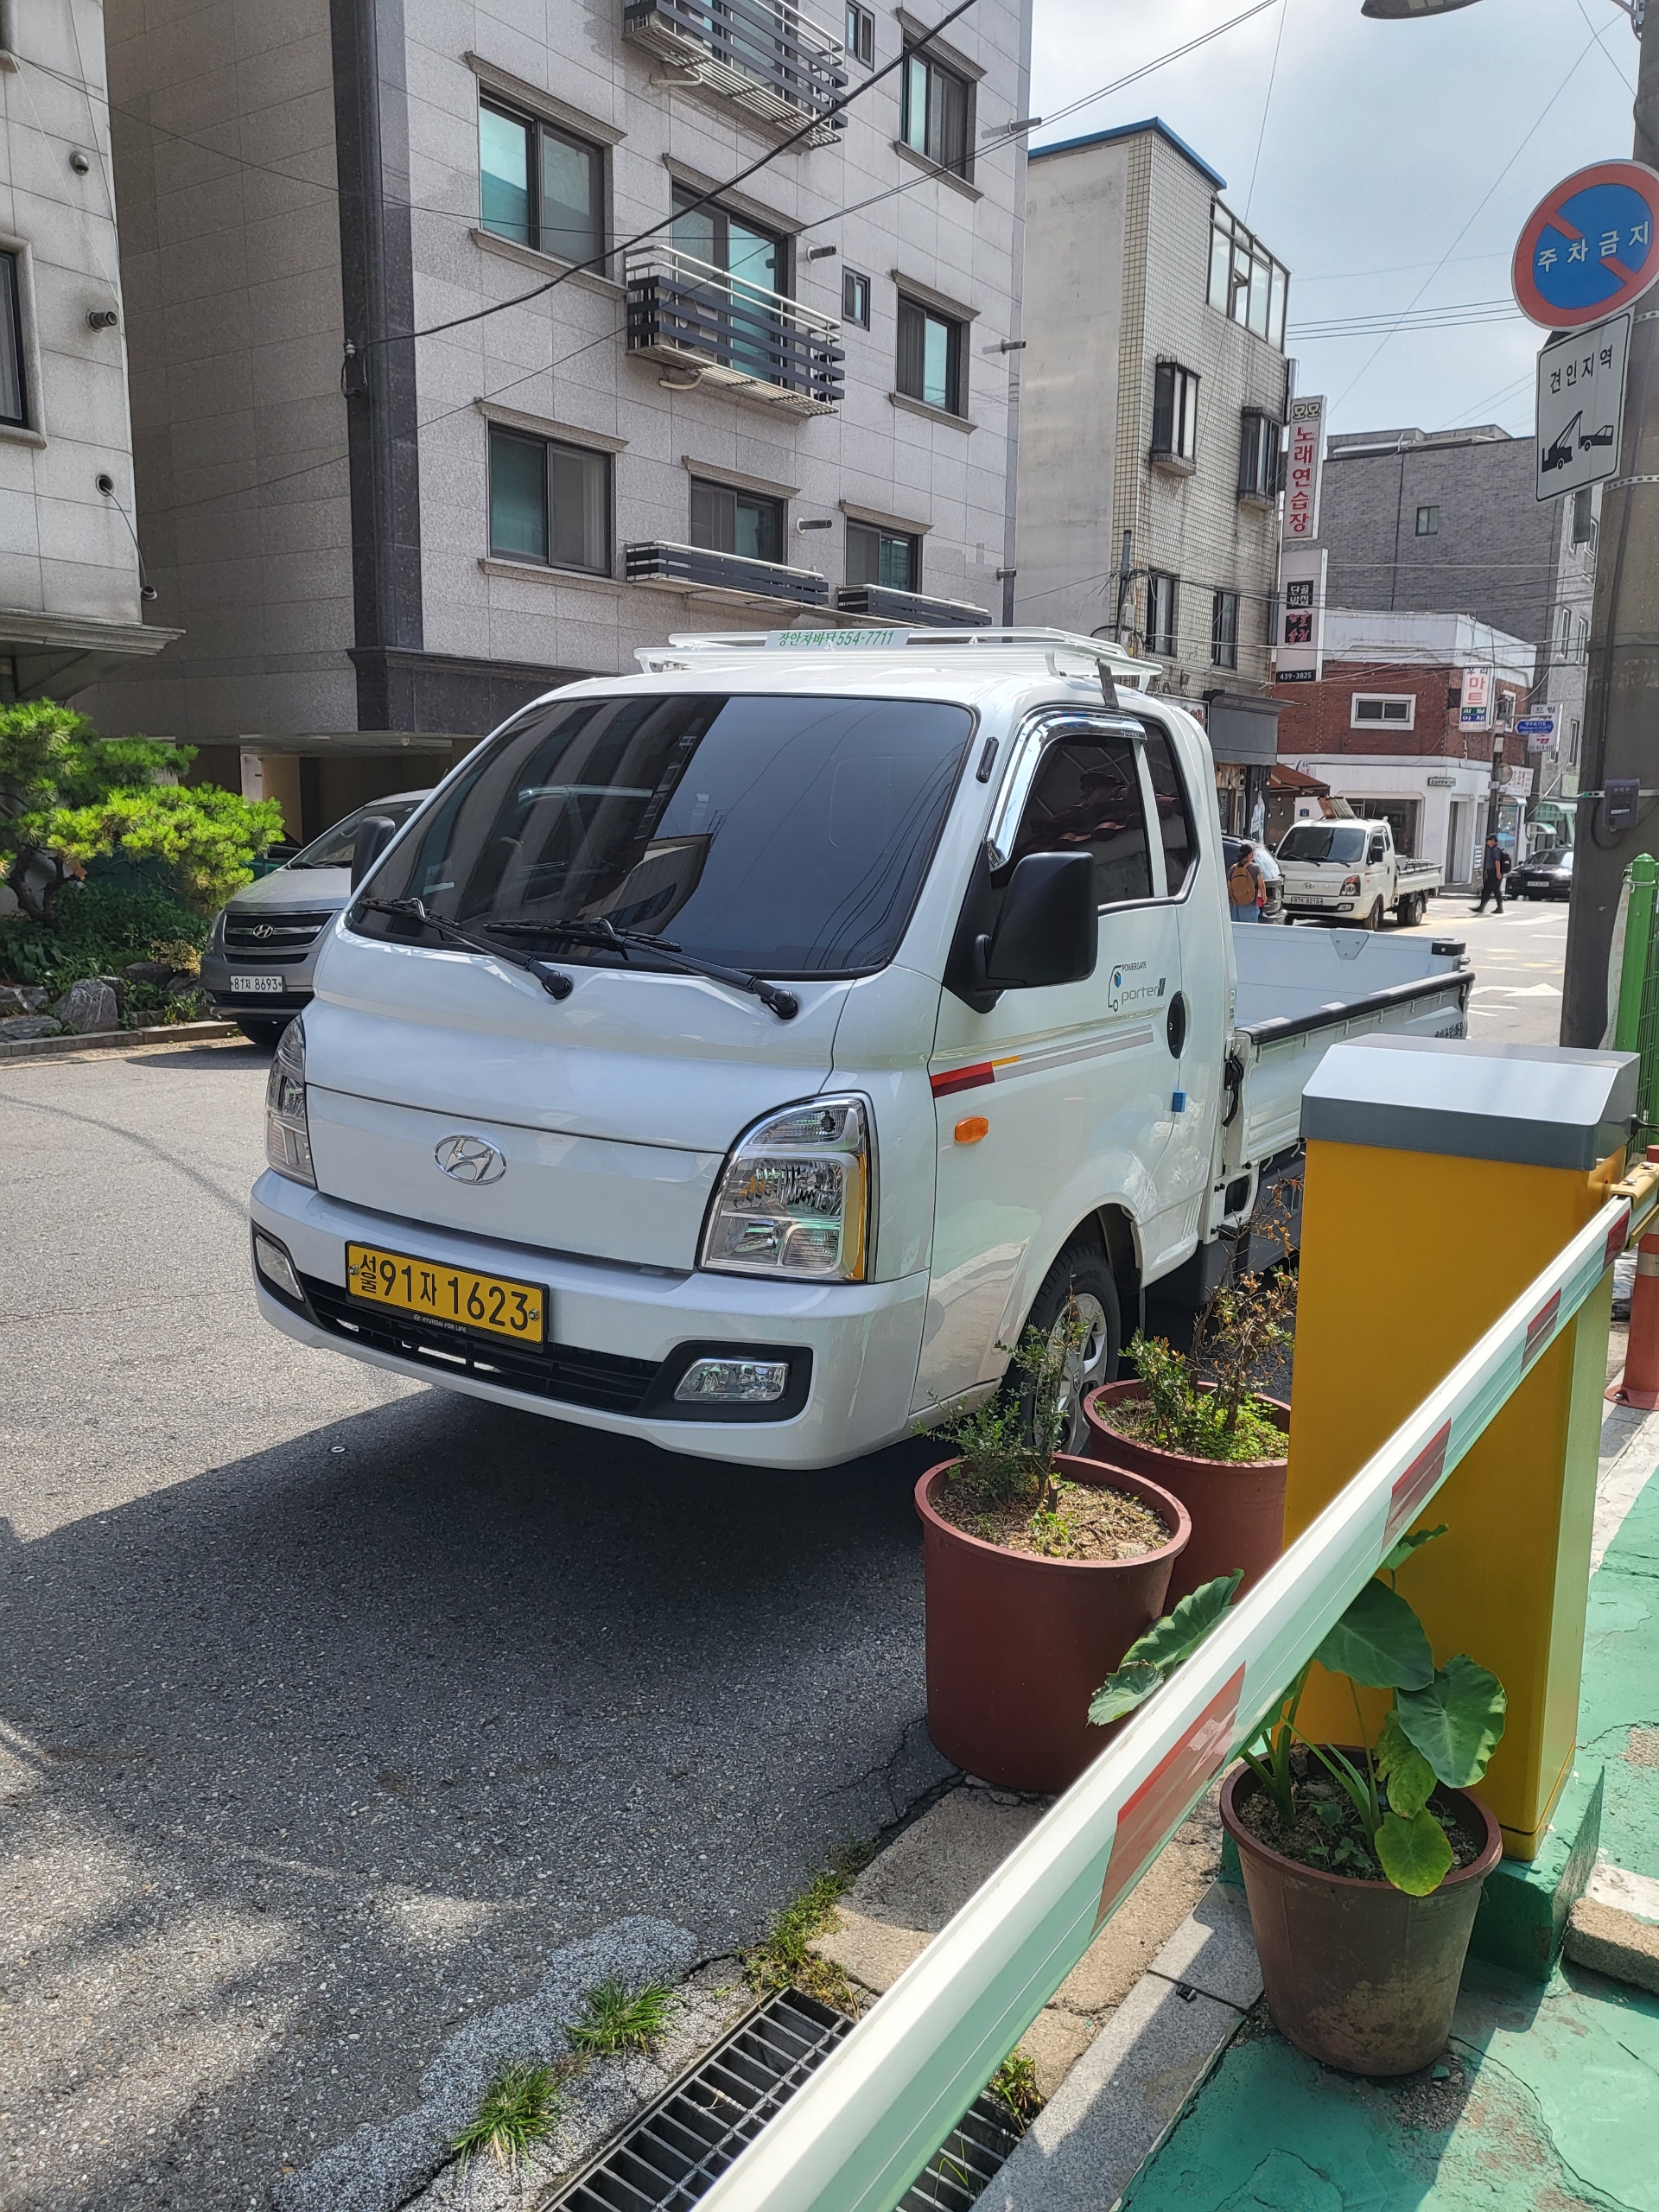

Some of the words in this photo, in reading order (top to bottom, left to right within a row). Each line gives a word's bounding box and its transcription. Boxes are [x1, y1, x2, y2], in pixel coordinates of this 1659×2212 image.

[1538, 220, 1649, 273] 주차금지
[1549, 344, 1612, 394] 견인지역
[1288, 426, 1314, 533] 노래연습장
[836, 630, 894, 645] 554-7711
[1280, 671, 1313, 681] 439-3825
[1466, 677, 1486, 705] 마트
[1122, 961, 1147, 972] POWERGATE
[254, 977, 278, 990] 8693
[359, 1254, 378, 1294] 서울
[422, 1316, 444, 1328] HYUNDAI
